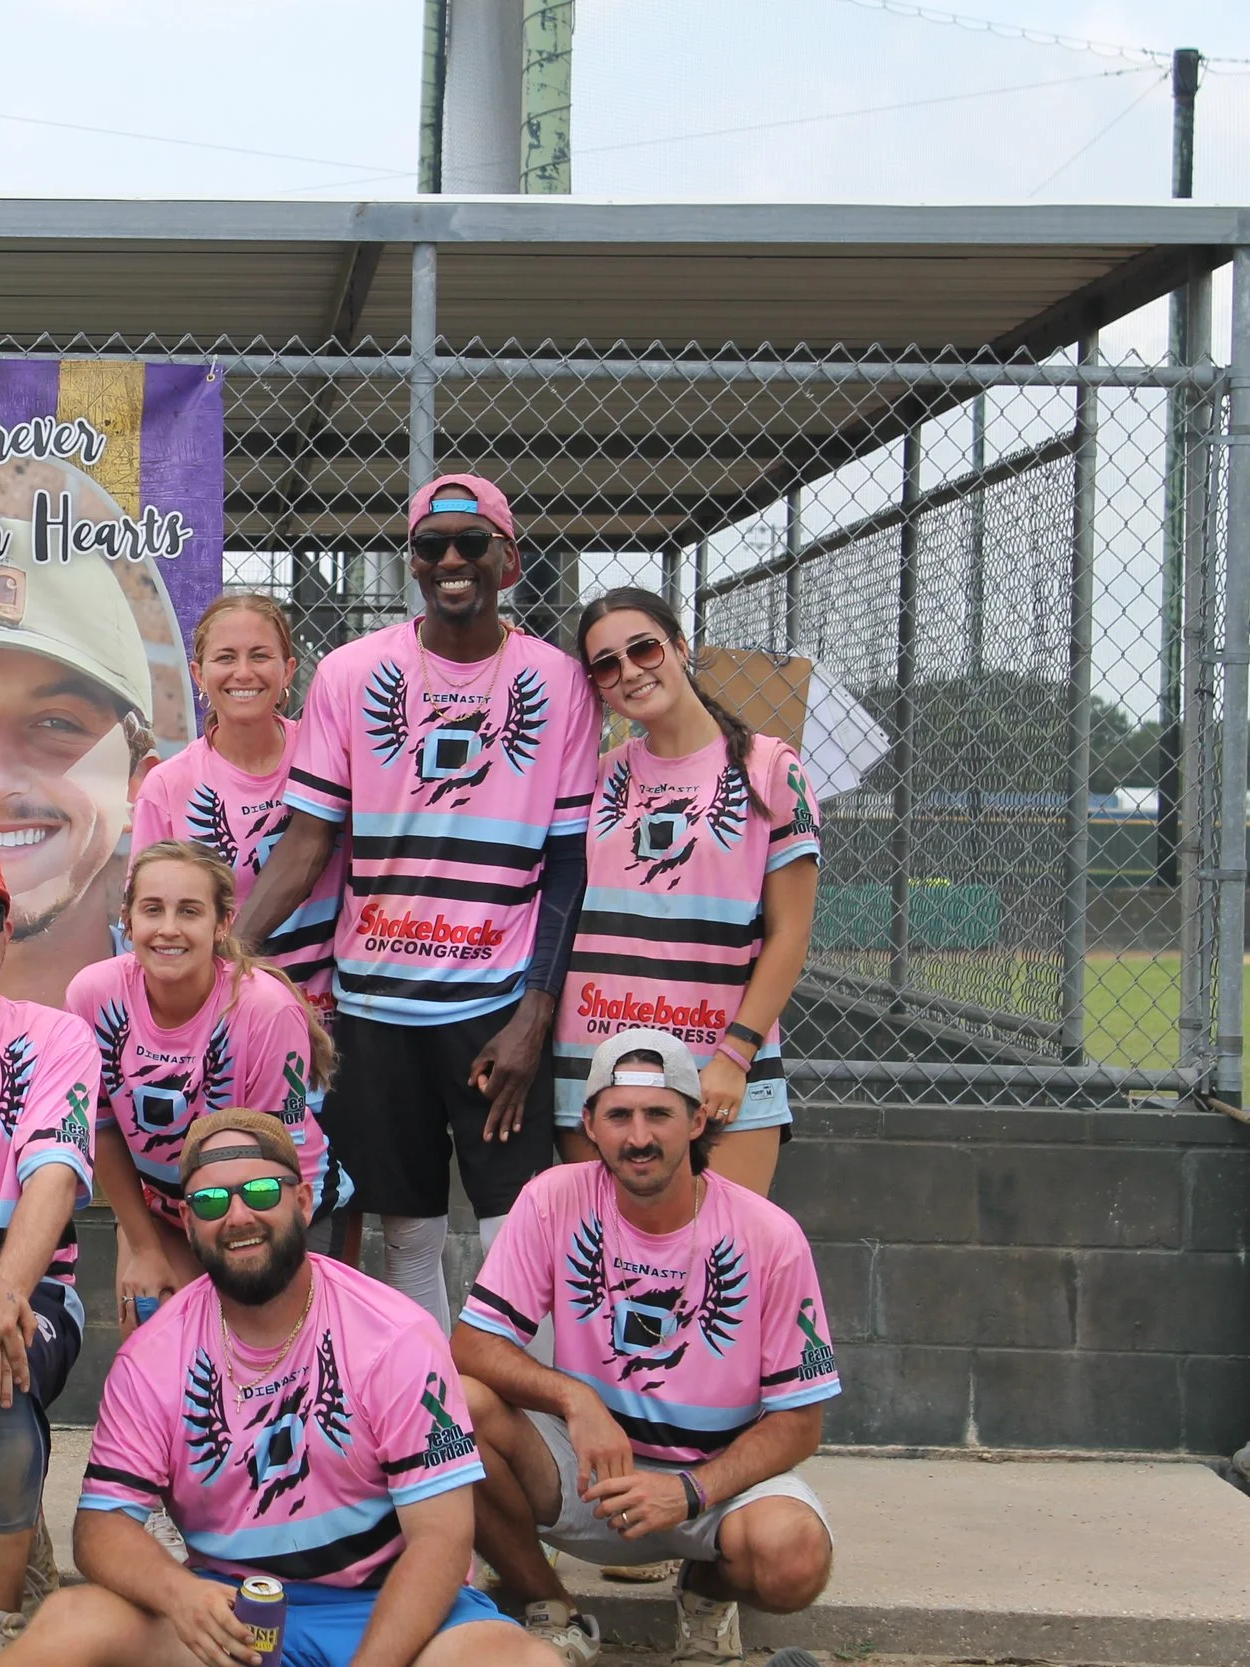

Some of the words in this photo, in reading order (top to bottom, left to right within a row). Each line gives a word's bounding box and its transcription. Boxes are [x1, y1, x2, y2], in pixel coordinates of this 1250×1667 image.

[32, 489, 192, 563] Hearts
[241, 799, 284, 815] DIENA
[356, 903, 506, 947] Shakebacks
[390, 939, 492, 960] CONGRESS
[577, 982, 726, 1030] Shakebacks
[587, 1019, 611, 1035] ON
[616, 1022, 717, 1045] CRESS
[282, 1097, 305, 1111] Tea
[61, 1117, 87, 1136] Tea
[801, 1345, 832, 1365] Team
[243, 1366, 310, 1401] DIENASY
[425, 1424, 464, 1449] Team
[424, 1438, 475, 1470] Jordan
